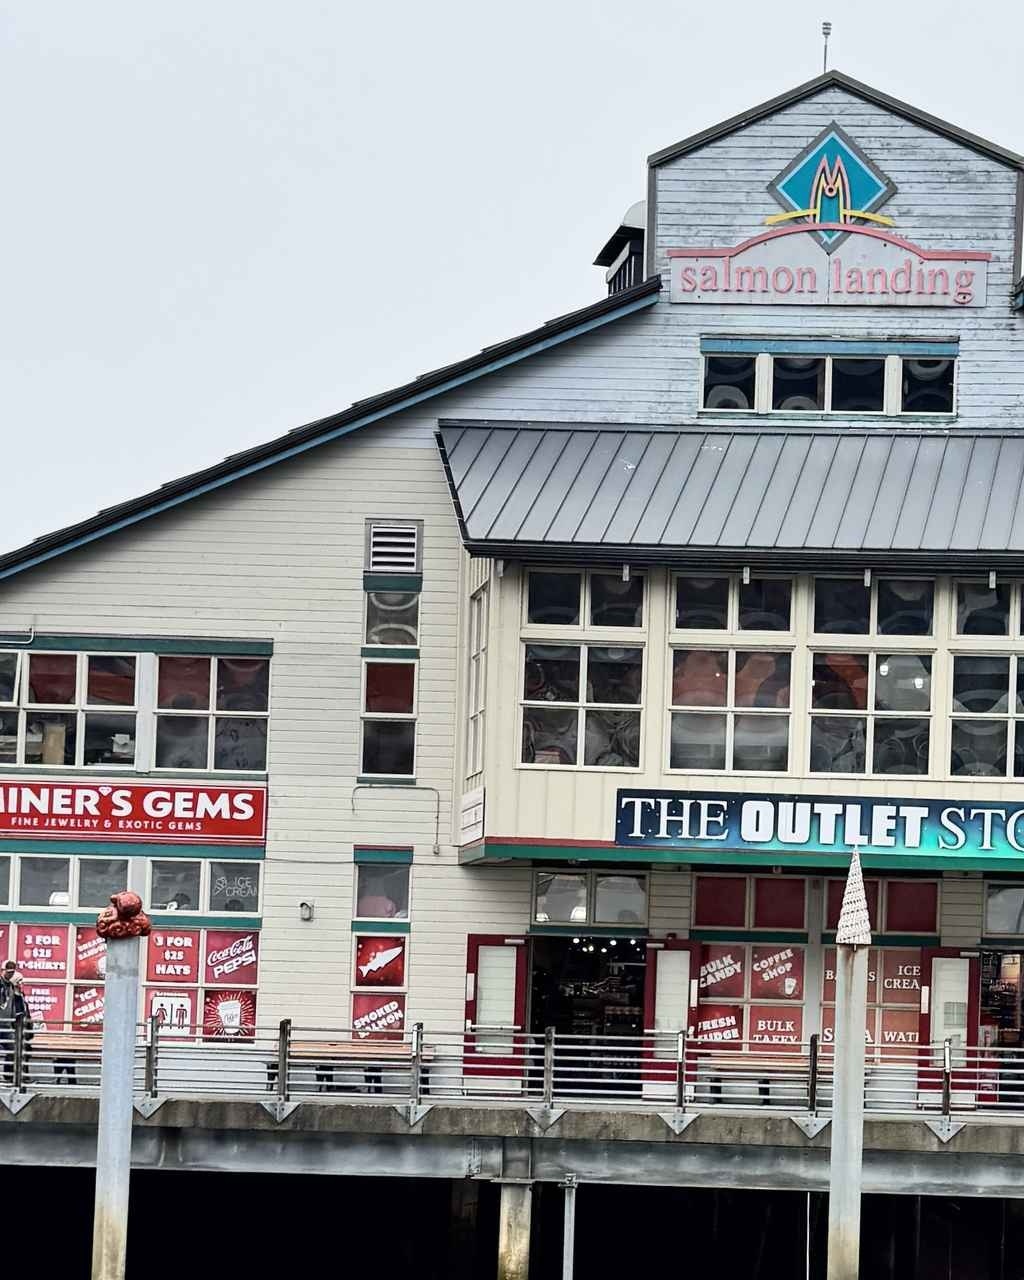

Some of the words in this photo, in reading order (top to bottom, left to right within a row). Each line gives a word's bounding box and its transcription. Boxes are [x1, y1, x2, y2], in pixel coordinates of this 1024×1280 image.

[680, 255, 819, 294] salmon
[832, 256, 977, 305] landing
[143, 791, 255, 820] GEMS
[11, 817, 39, 826] FINE
[44, 818, 99, 828] JEWELRY
[103, 820, 112, 828] &
[118, 820, 163, 830] EXOTIC
[168, 821, 203, 831] GEMS
[621, 797, 729, 840] THE
[740, 800, 929, 848] OUTLET
[25, 935, 33, 945] 3
[36, 935, 61, 946] FOR
[156, 936, 164, 948] 3
[167, 937, 193, 949] FOR
[17, 960, 66, 971] T-SHIRTS
[155, 964, 191, 976] HATS
[213, 950, 257, 979] PEPSI
[700, 955, 735, 977] BULK
[752, 949, 794, 972] COFFEE
[898, 965, 921, 976] ICE
[699, 962, 741, 989] CANDY
[762, 962, 793, 981] SHOP
[353, 1001, 398, 1029] SMOKED
[757, 1020, 795, 1032] BULK
